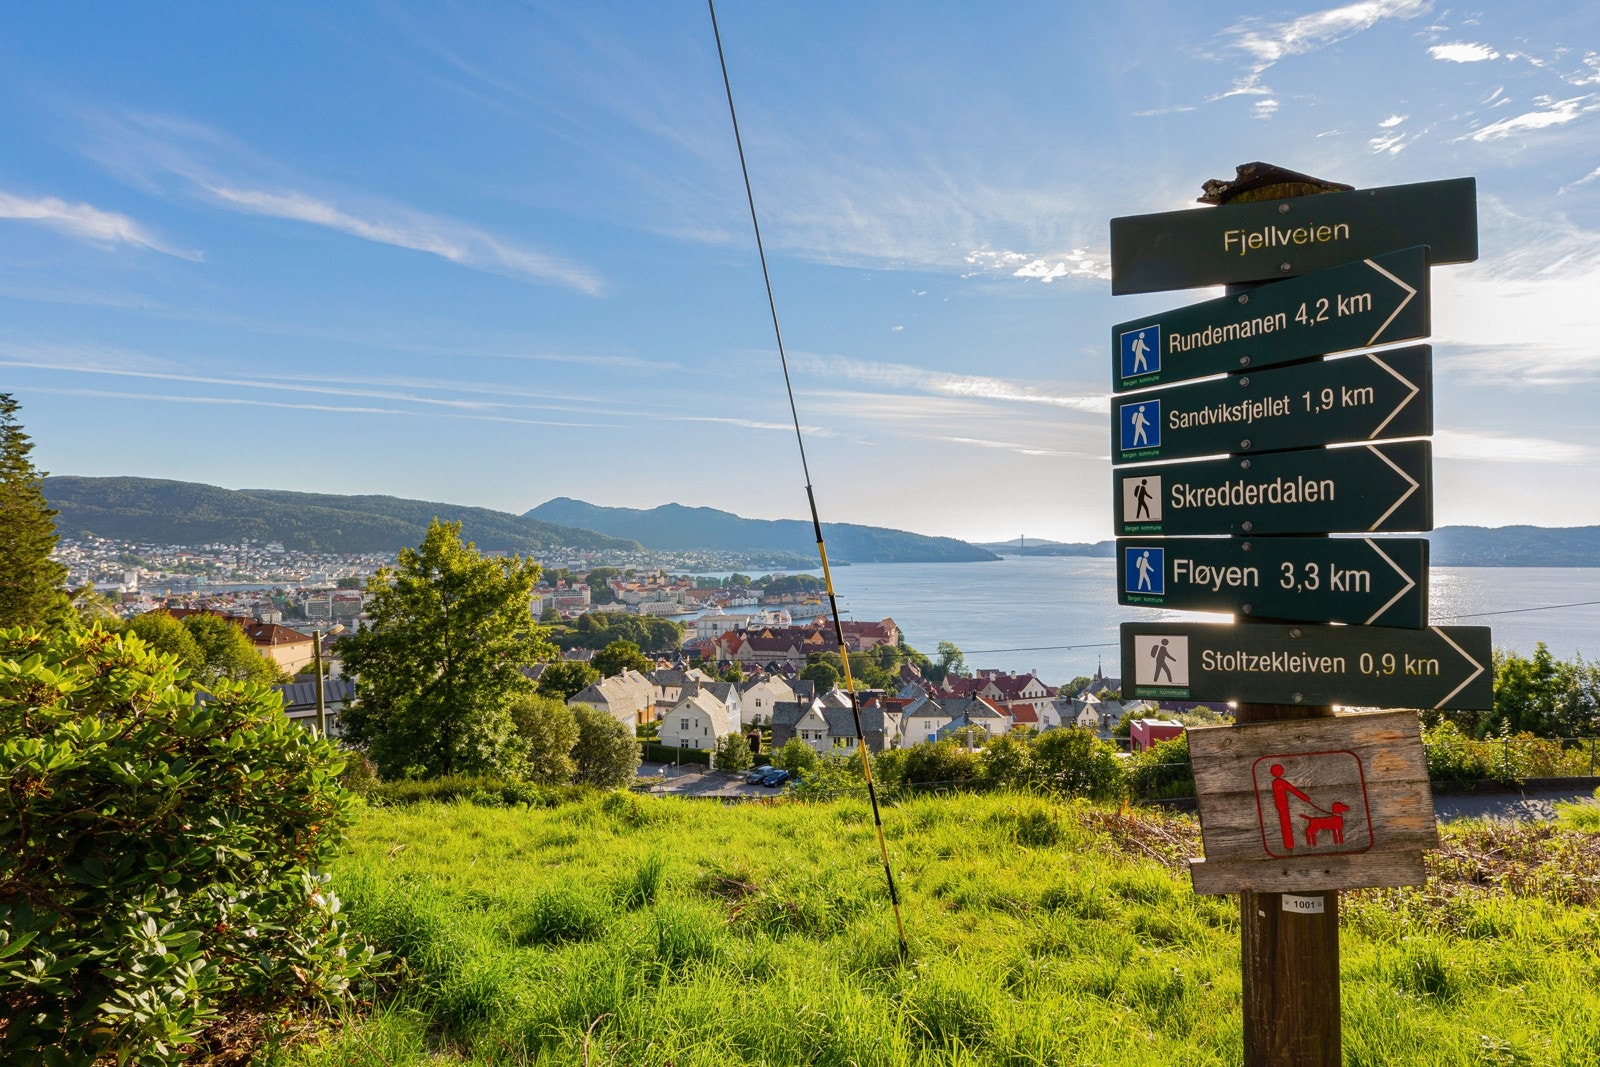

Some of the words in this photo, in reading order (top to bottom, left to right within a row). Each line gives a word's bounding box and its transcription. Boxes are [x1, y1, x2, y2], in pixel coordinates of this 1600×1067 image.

[1224, 222, 1349, 256] Fjellveien
[1169, 312, 1286, 353] Rundemanen
[1295, 298, 1329, 328] 4,2
[1338, 292, 1372, 317] km
[1169, 395, 1290, 430] Sandviksfjellet
[1302, 389, 1334, 415] 1,9
[1342, 385, 1374, 407] km
[1171, 476, 1335, 509] Skredderdalen
[1173, 559, 1259, 592] Fløyen
[1280, 562, 1319, 594] 3,3
[1330, 563, 1371, 593] km
[1202, 650, 1345, 674] Stoltzekleiven
[1359, 652, 1396, 677] 0,9
[1404, 654, 1439, 675] km
[1293, 900, 1315, 909] 1001
